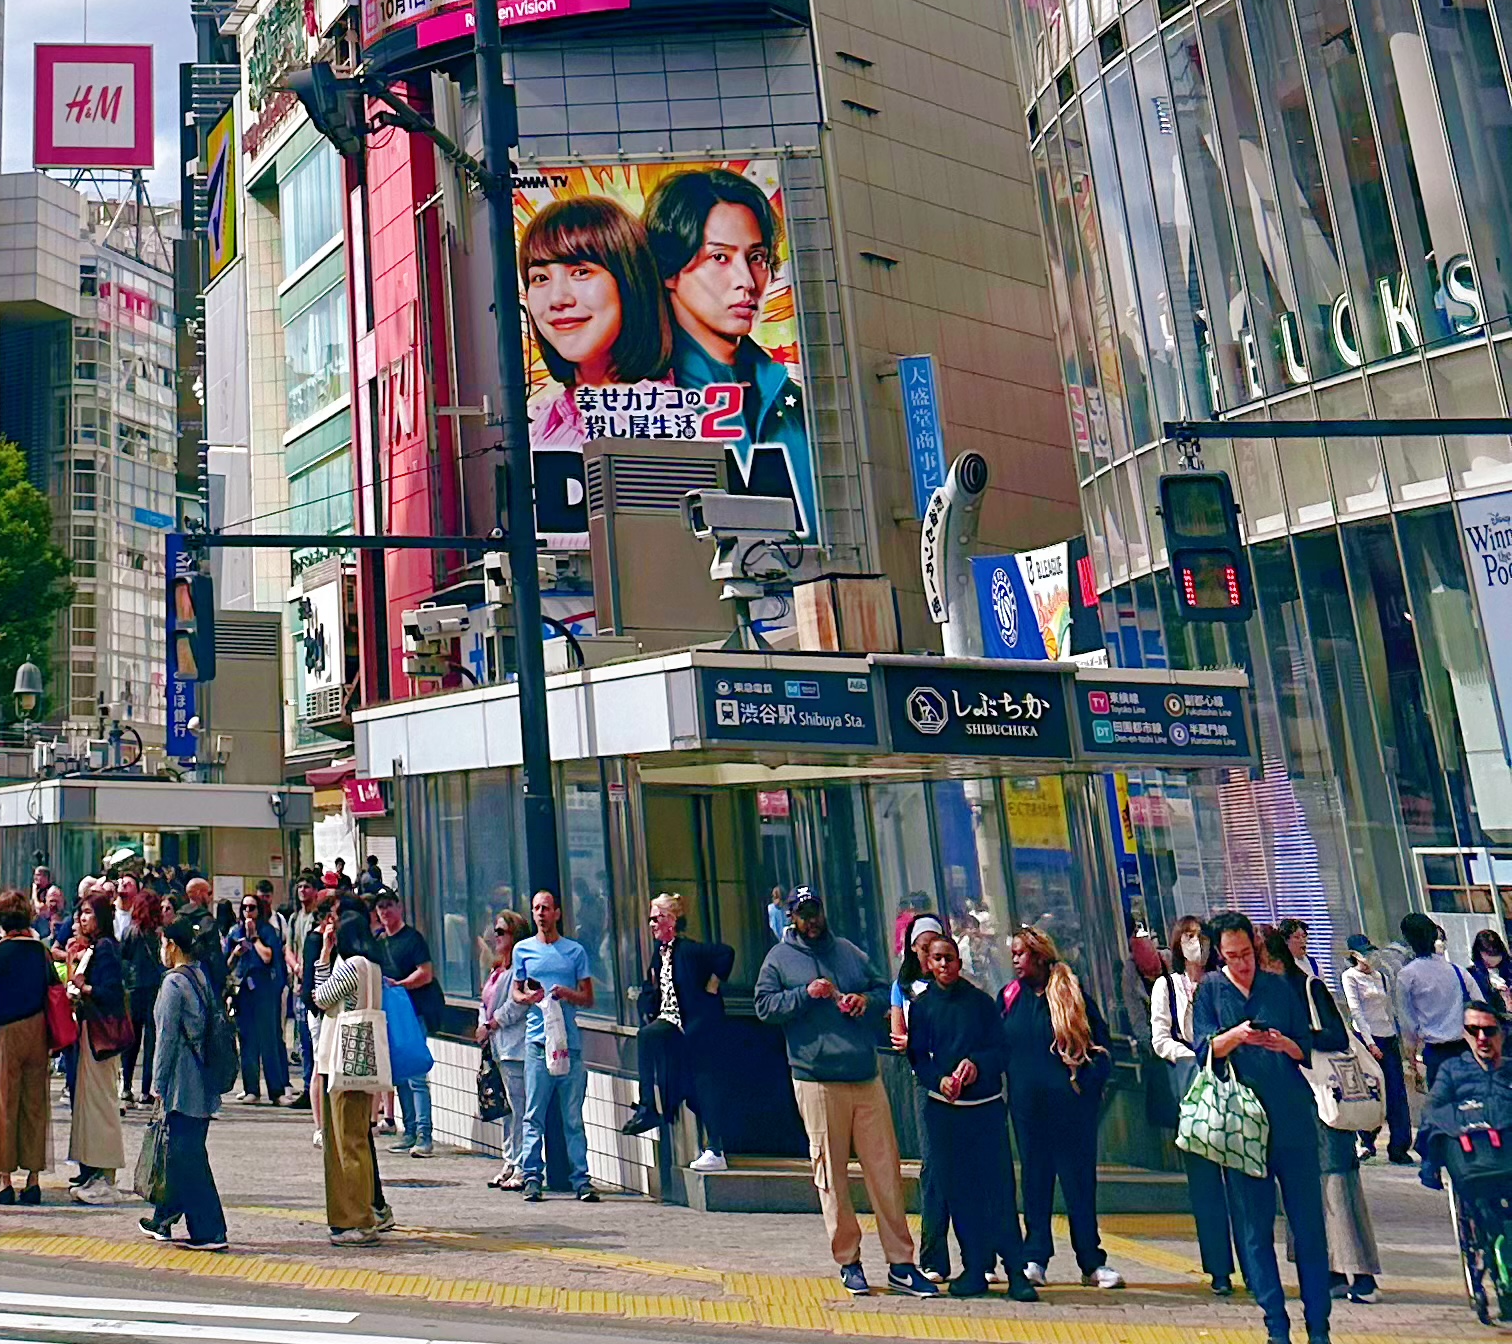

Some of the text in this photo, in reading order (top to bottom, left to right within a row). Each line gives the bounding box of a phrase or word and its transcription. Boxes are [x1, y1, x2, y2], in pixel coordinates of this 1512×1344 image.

[64, 84, 123, 124] H&M
[552, 175, 569, 188] TV
[576, 386, 701, 411] 幸せカナコの
[585, 385, 744, 440] 殺し屋生活 2
[951, 689, 1050, 719] しぶちか
[1092, 697, 1105, 708] TY
[740, 701, 866, 730] 渋谷駅 Shibuya Sta.
[965, 723, 1039, 737] SHIBUCHIKA
[1096, 720, 1163, 737] DT 田園都市線
